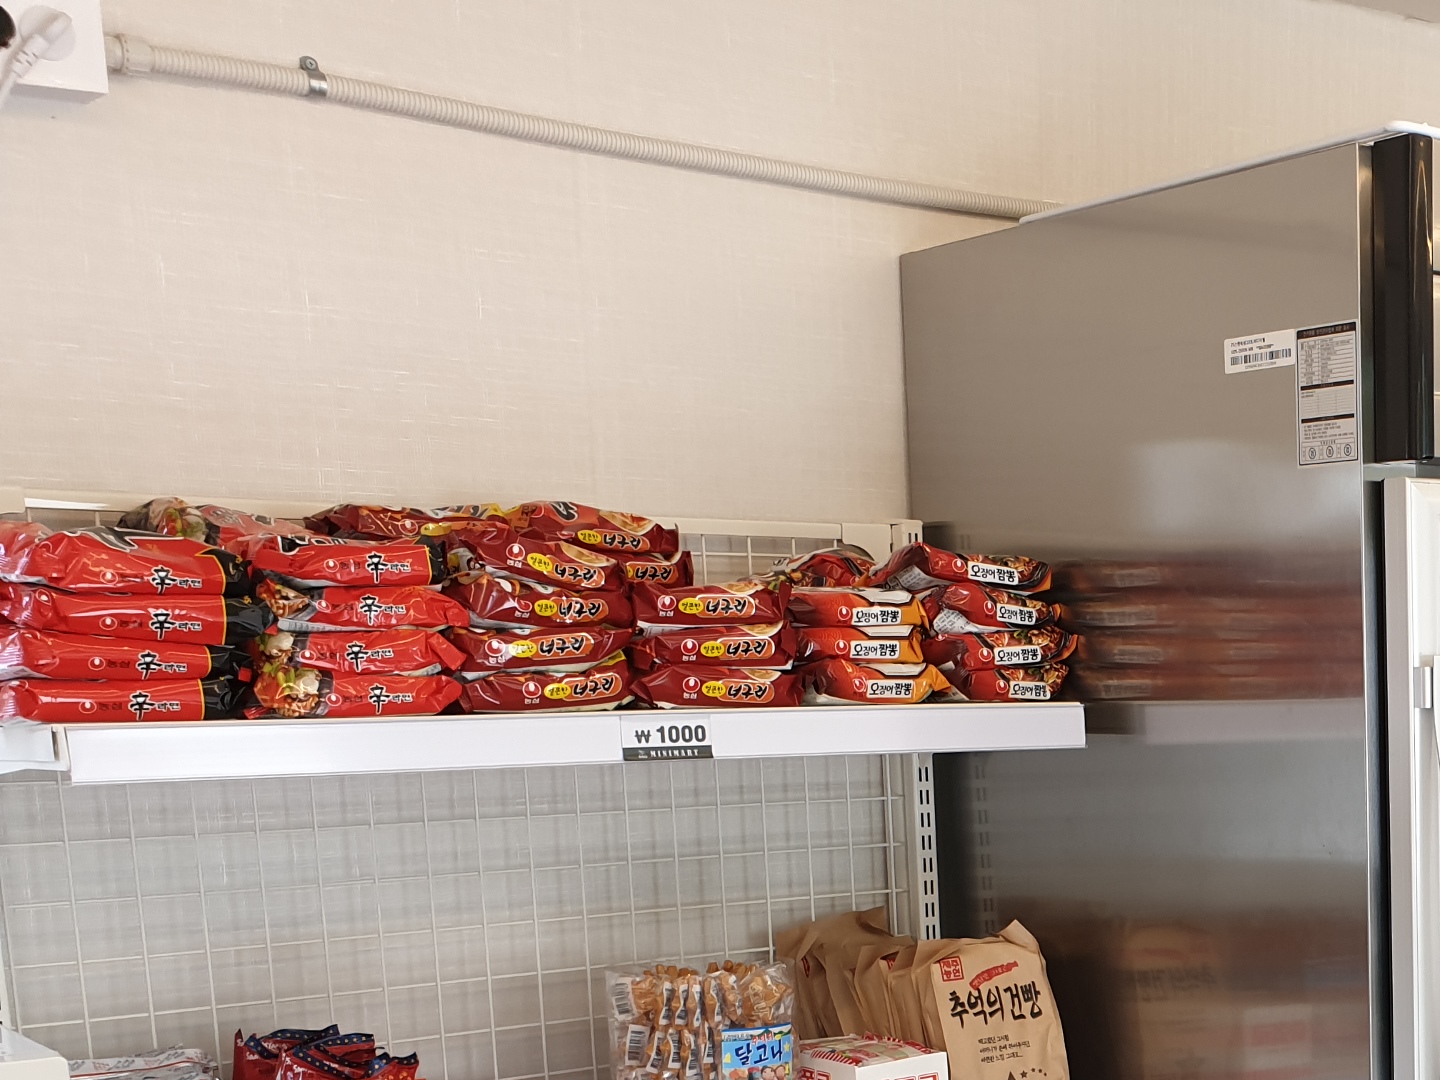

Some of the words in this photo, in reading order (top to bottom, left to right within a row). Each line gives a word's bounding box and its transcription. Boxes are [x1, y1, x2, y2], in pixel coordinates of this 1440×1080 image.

[603, 533, 641, 548] 너구리
[555, 564, 597, 581] 너구리
[635, 566, 672, 580] 너구리
[558, 601, 602, 618] 너구리
[706, 599, 746, 614] 너구리
[539, 636, 585, 656] 너구리
[726, 641, 767, 656] 너구리
[573, 677, 615, 697] 너구리
[728, 684, 767, 698] 너구리
[949, 986, 1004, 1029] 추억의
[1004, 981, 1043, 1021] 건빵
[735, 1039, 783, 1065] 달고나
